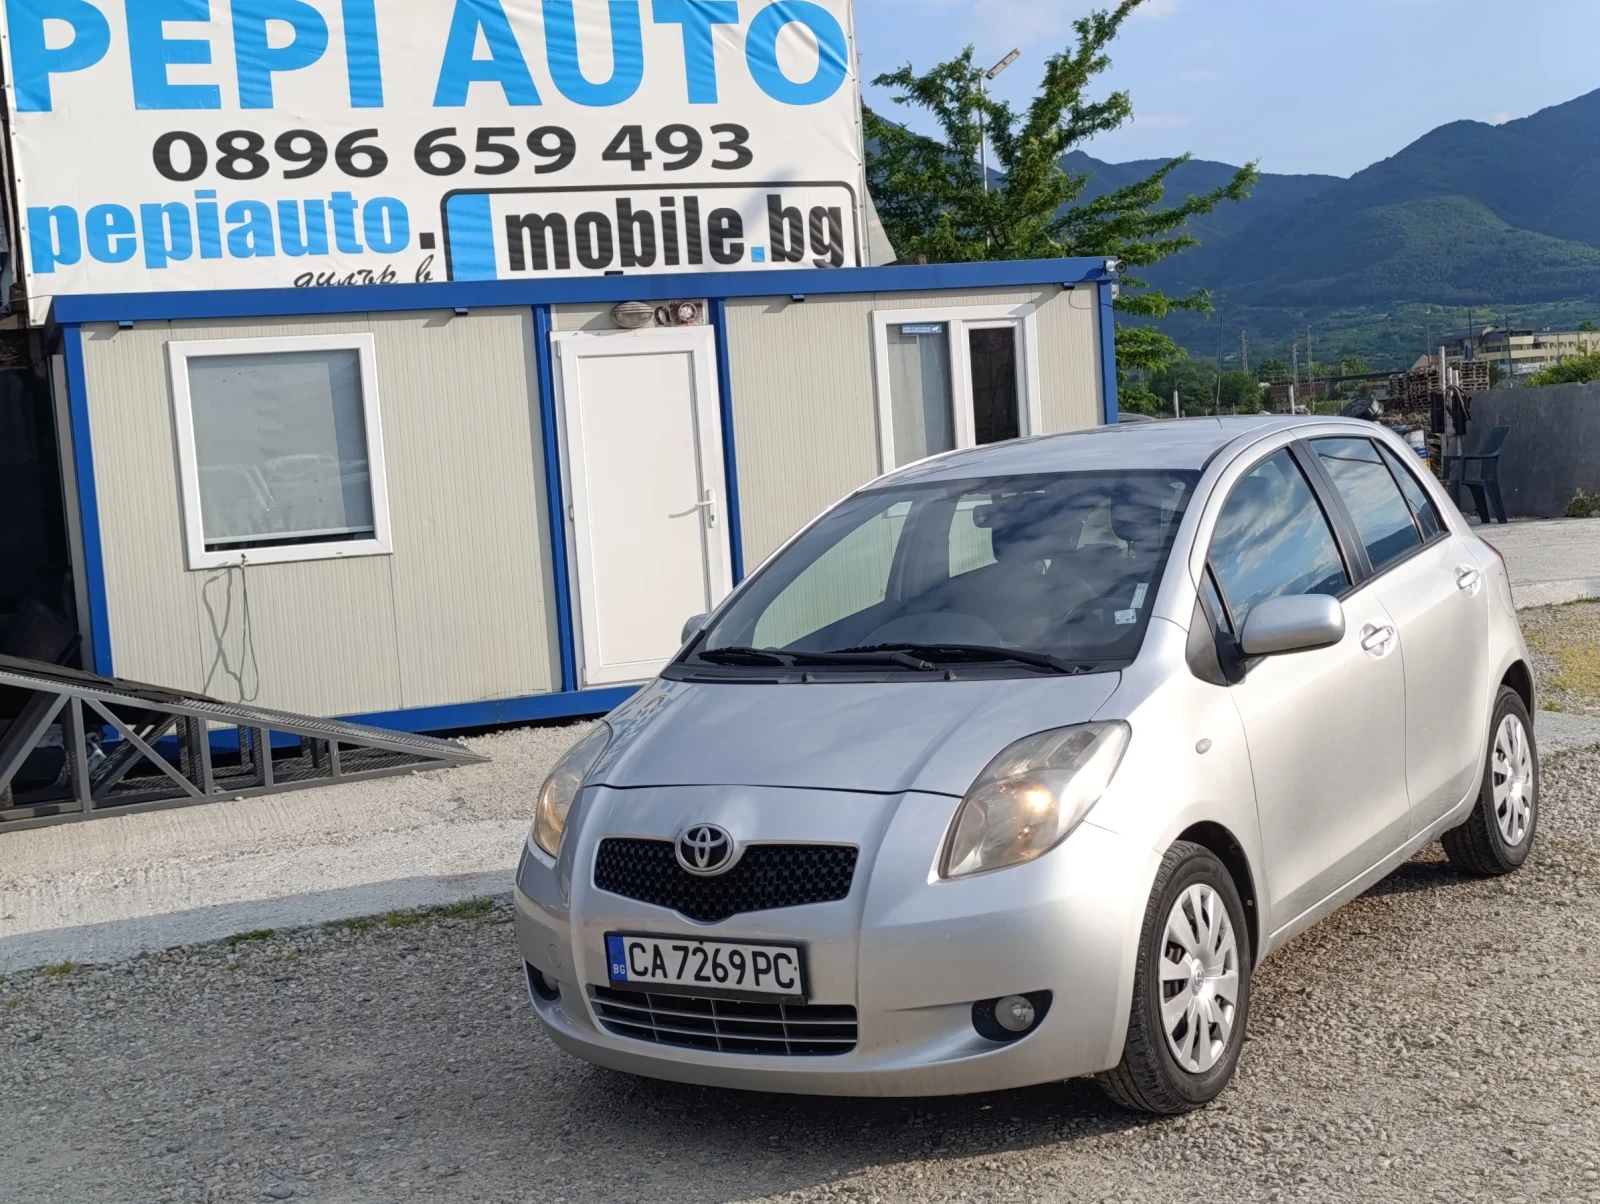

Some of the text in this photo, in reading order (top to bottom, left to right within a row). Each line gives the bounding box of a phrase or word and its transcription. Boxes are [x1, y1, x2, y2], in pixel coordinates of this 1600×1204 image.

[4, 0, 849, 112] PEPI AUTO
[152, 122, 753, 182] 0896 659 493
[504, 194, 845, 269] mobile.bg
[613, 963, 626, 975] BG
